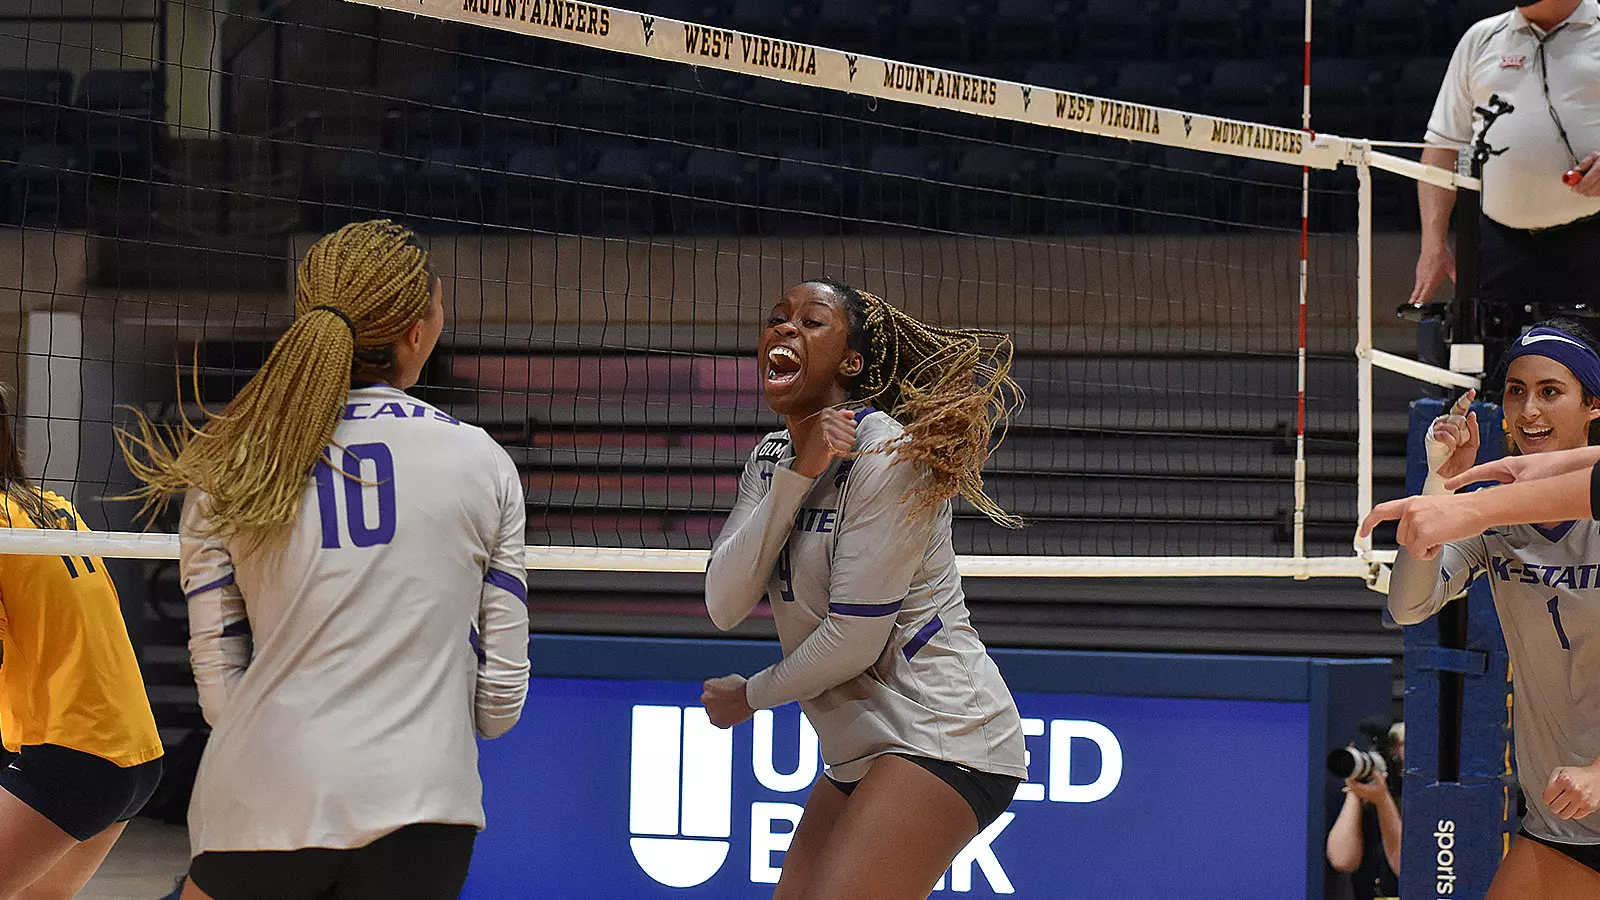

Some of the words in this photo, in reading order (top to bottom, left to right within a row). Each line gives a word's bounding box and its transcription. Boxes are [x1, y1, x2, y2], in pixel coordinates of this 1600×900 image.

[684, 24, 734, 61] WEST
[740, 34, 816, 76] VIRGINIA
[883, 61, 997, 106] MOUNTAINEERS
[1055, 92, 1095, 123] WEST
[1100, 100, 1160, 135] VIRGINIA
[1211, 119, 1303, 155] MOUNTAINEERS
[336, 402, 460, 426] CATS
[758, 441, 788, 459] BLM
[312, 442, 397, 549] 10
[779, 540, 795, 602] 9
[1546, 595, 1571, 651] 1
[751, 708, 1124, 804] UED
[749, 801, 1016, 895] BK
[1433, 819, 1457, 895] sports
